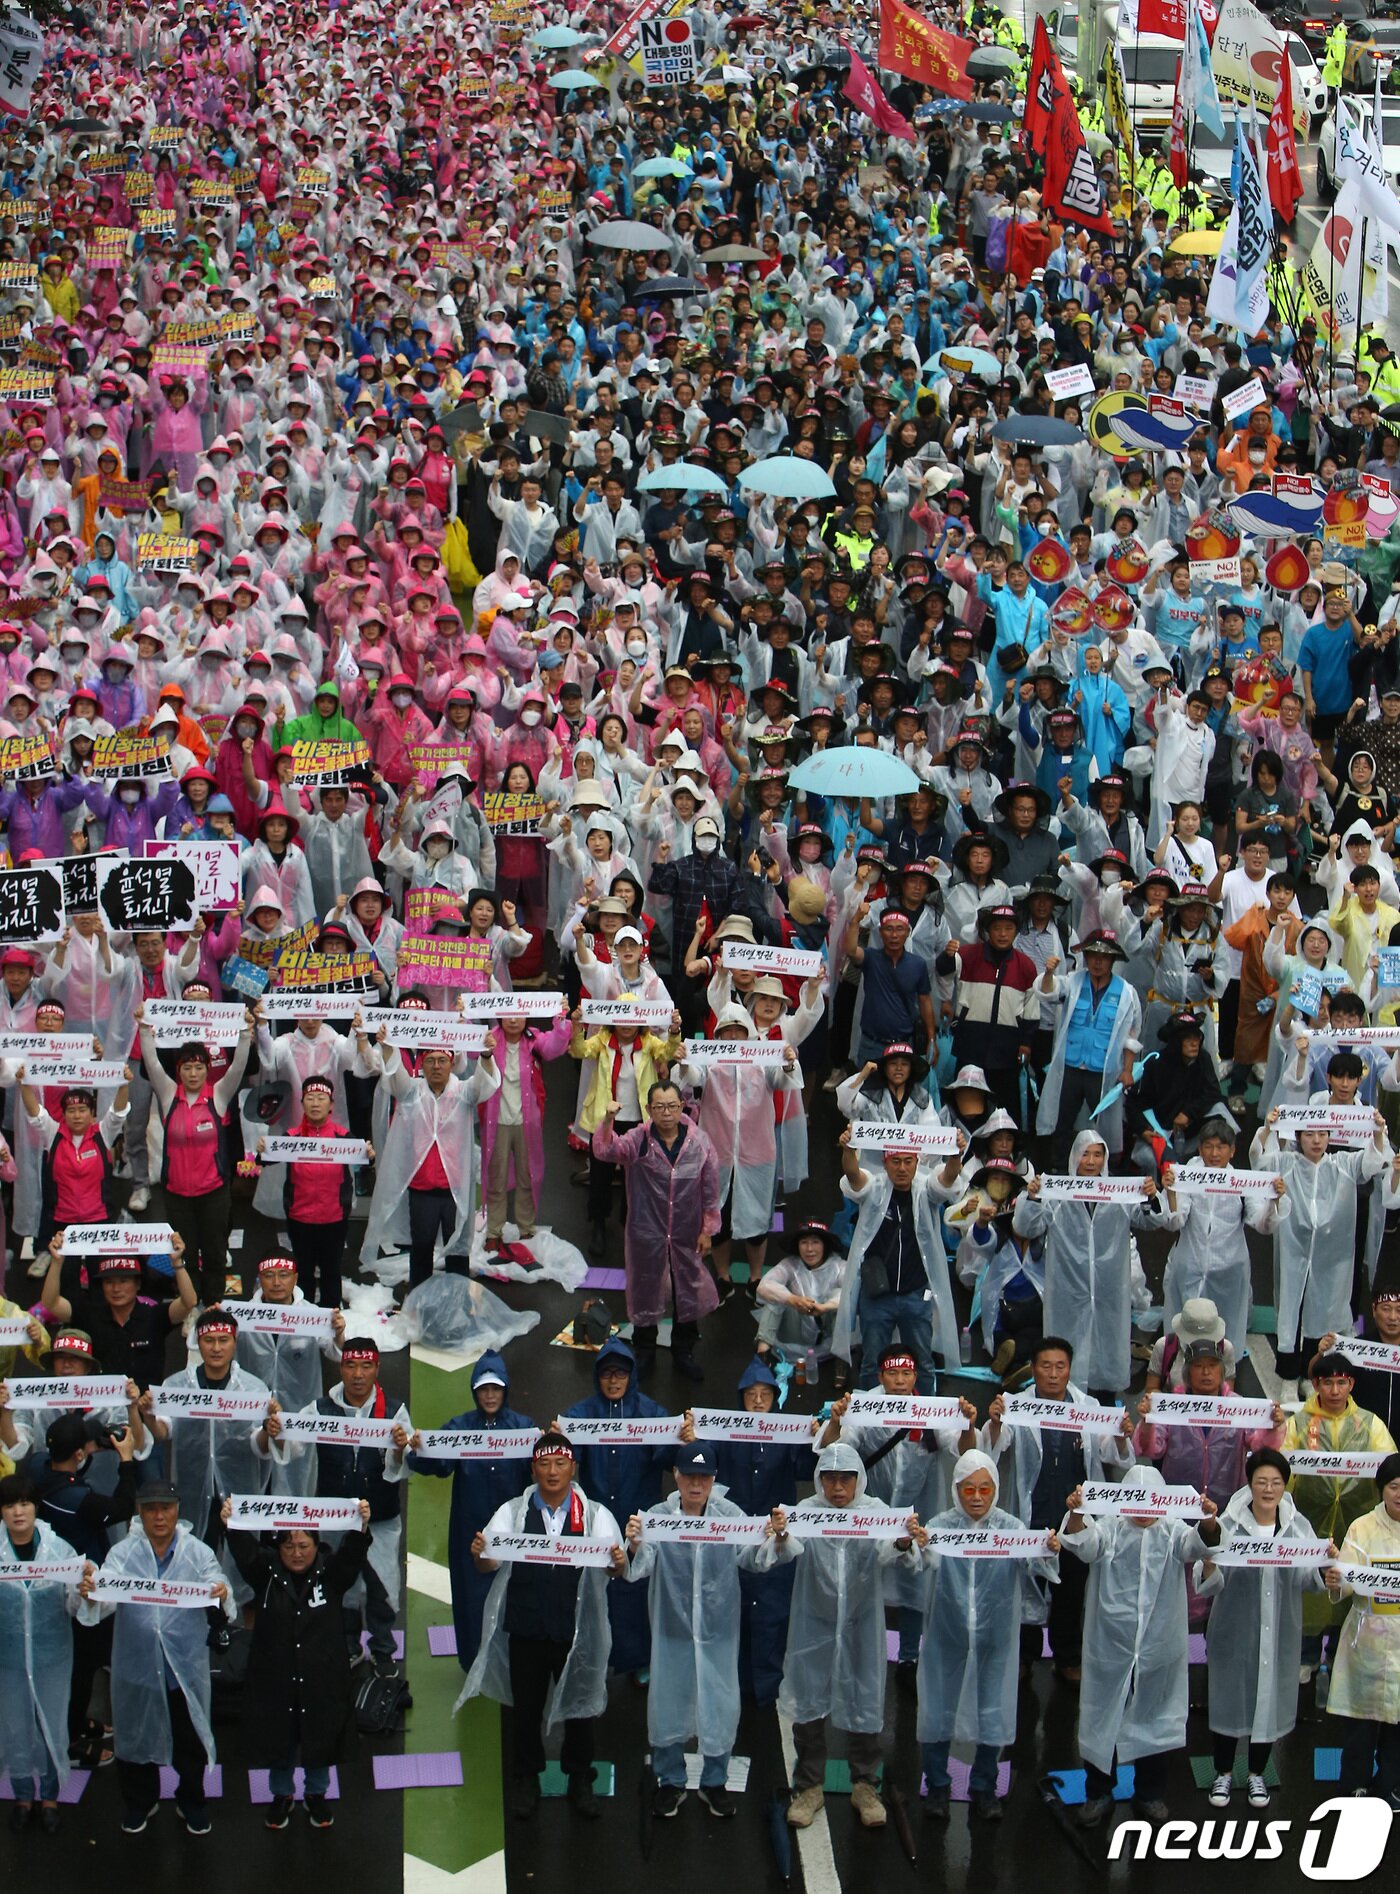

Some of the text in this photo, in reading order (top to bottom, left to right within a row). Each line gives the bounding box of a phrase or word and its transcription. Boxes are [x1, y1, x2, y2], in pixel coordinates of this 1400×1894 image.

[645, 46, 692, 59] 대통령이
[646, 58, 693, 71] 국민의
[648, 71, 694, 83] 적이다
[1346, 524, 1364, 536] NO!
[1217, 561, 1237, 572] NO!
[1243, 607, 1262, 618] 보당
[94, 736, 154, 752] 비정규직
[291, 741, 351, 758] 비정규직
[484, 793, 543, 809] 비정규직
[118, 867, 173, 895] 윤석열
[2, 877, 40, 906] 석열
[123, 895, 170, 921] 퇴진!
[438, 940, 467, 953] 안전한
[469, 942, 491, 955] 학교
[278, 951, 350, 968] 비정규직
[283, 965, 353, 985] 반노동정책
